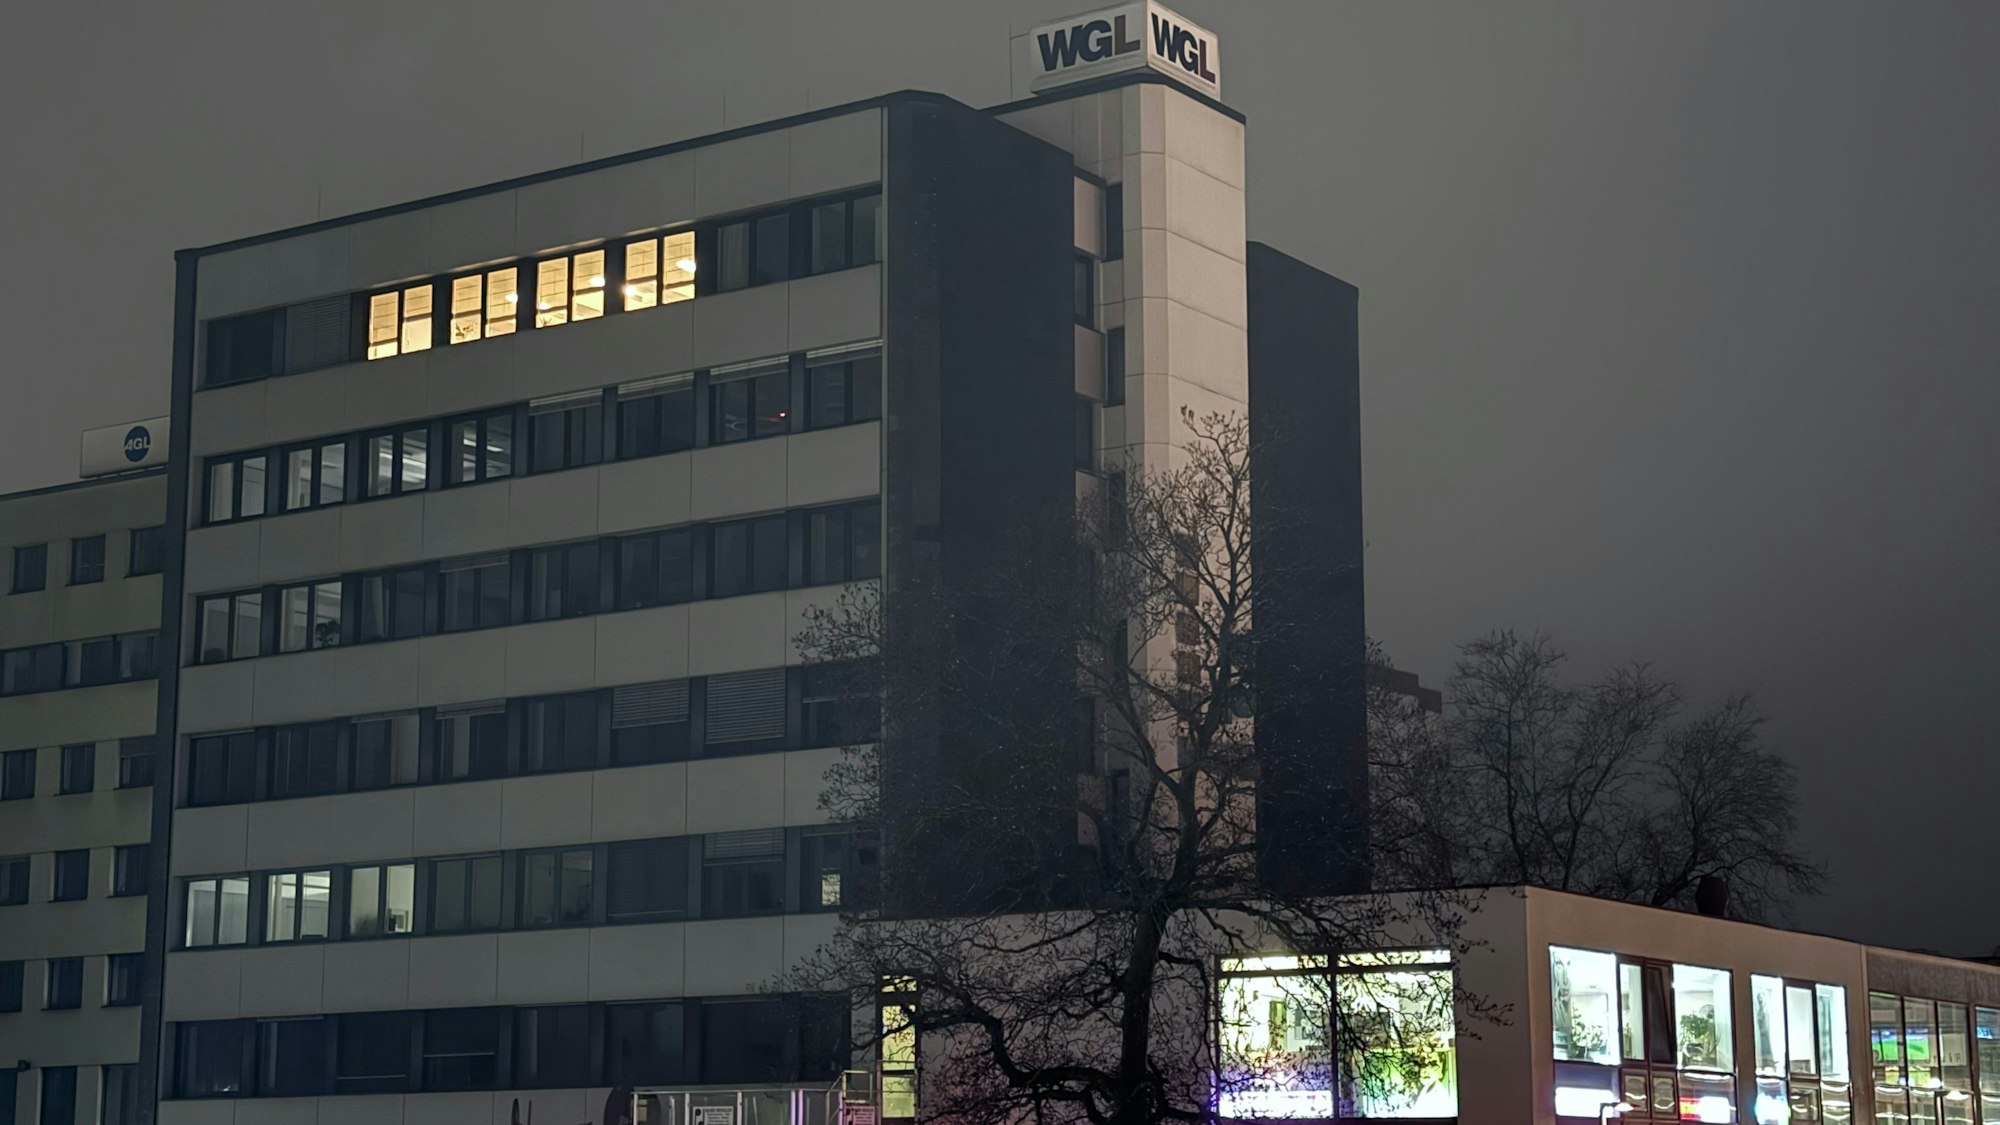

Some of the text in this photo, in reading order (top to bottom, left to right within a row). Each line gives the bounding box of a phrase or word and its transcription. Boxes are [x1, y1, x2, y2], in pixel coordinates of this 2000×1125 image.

[1037, 14, 1141, 72] WGL
[1151, 12, 1216, 84] WGL
[124, 436, 151, 451] AGL
